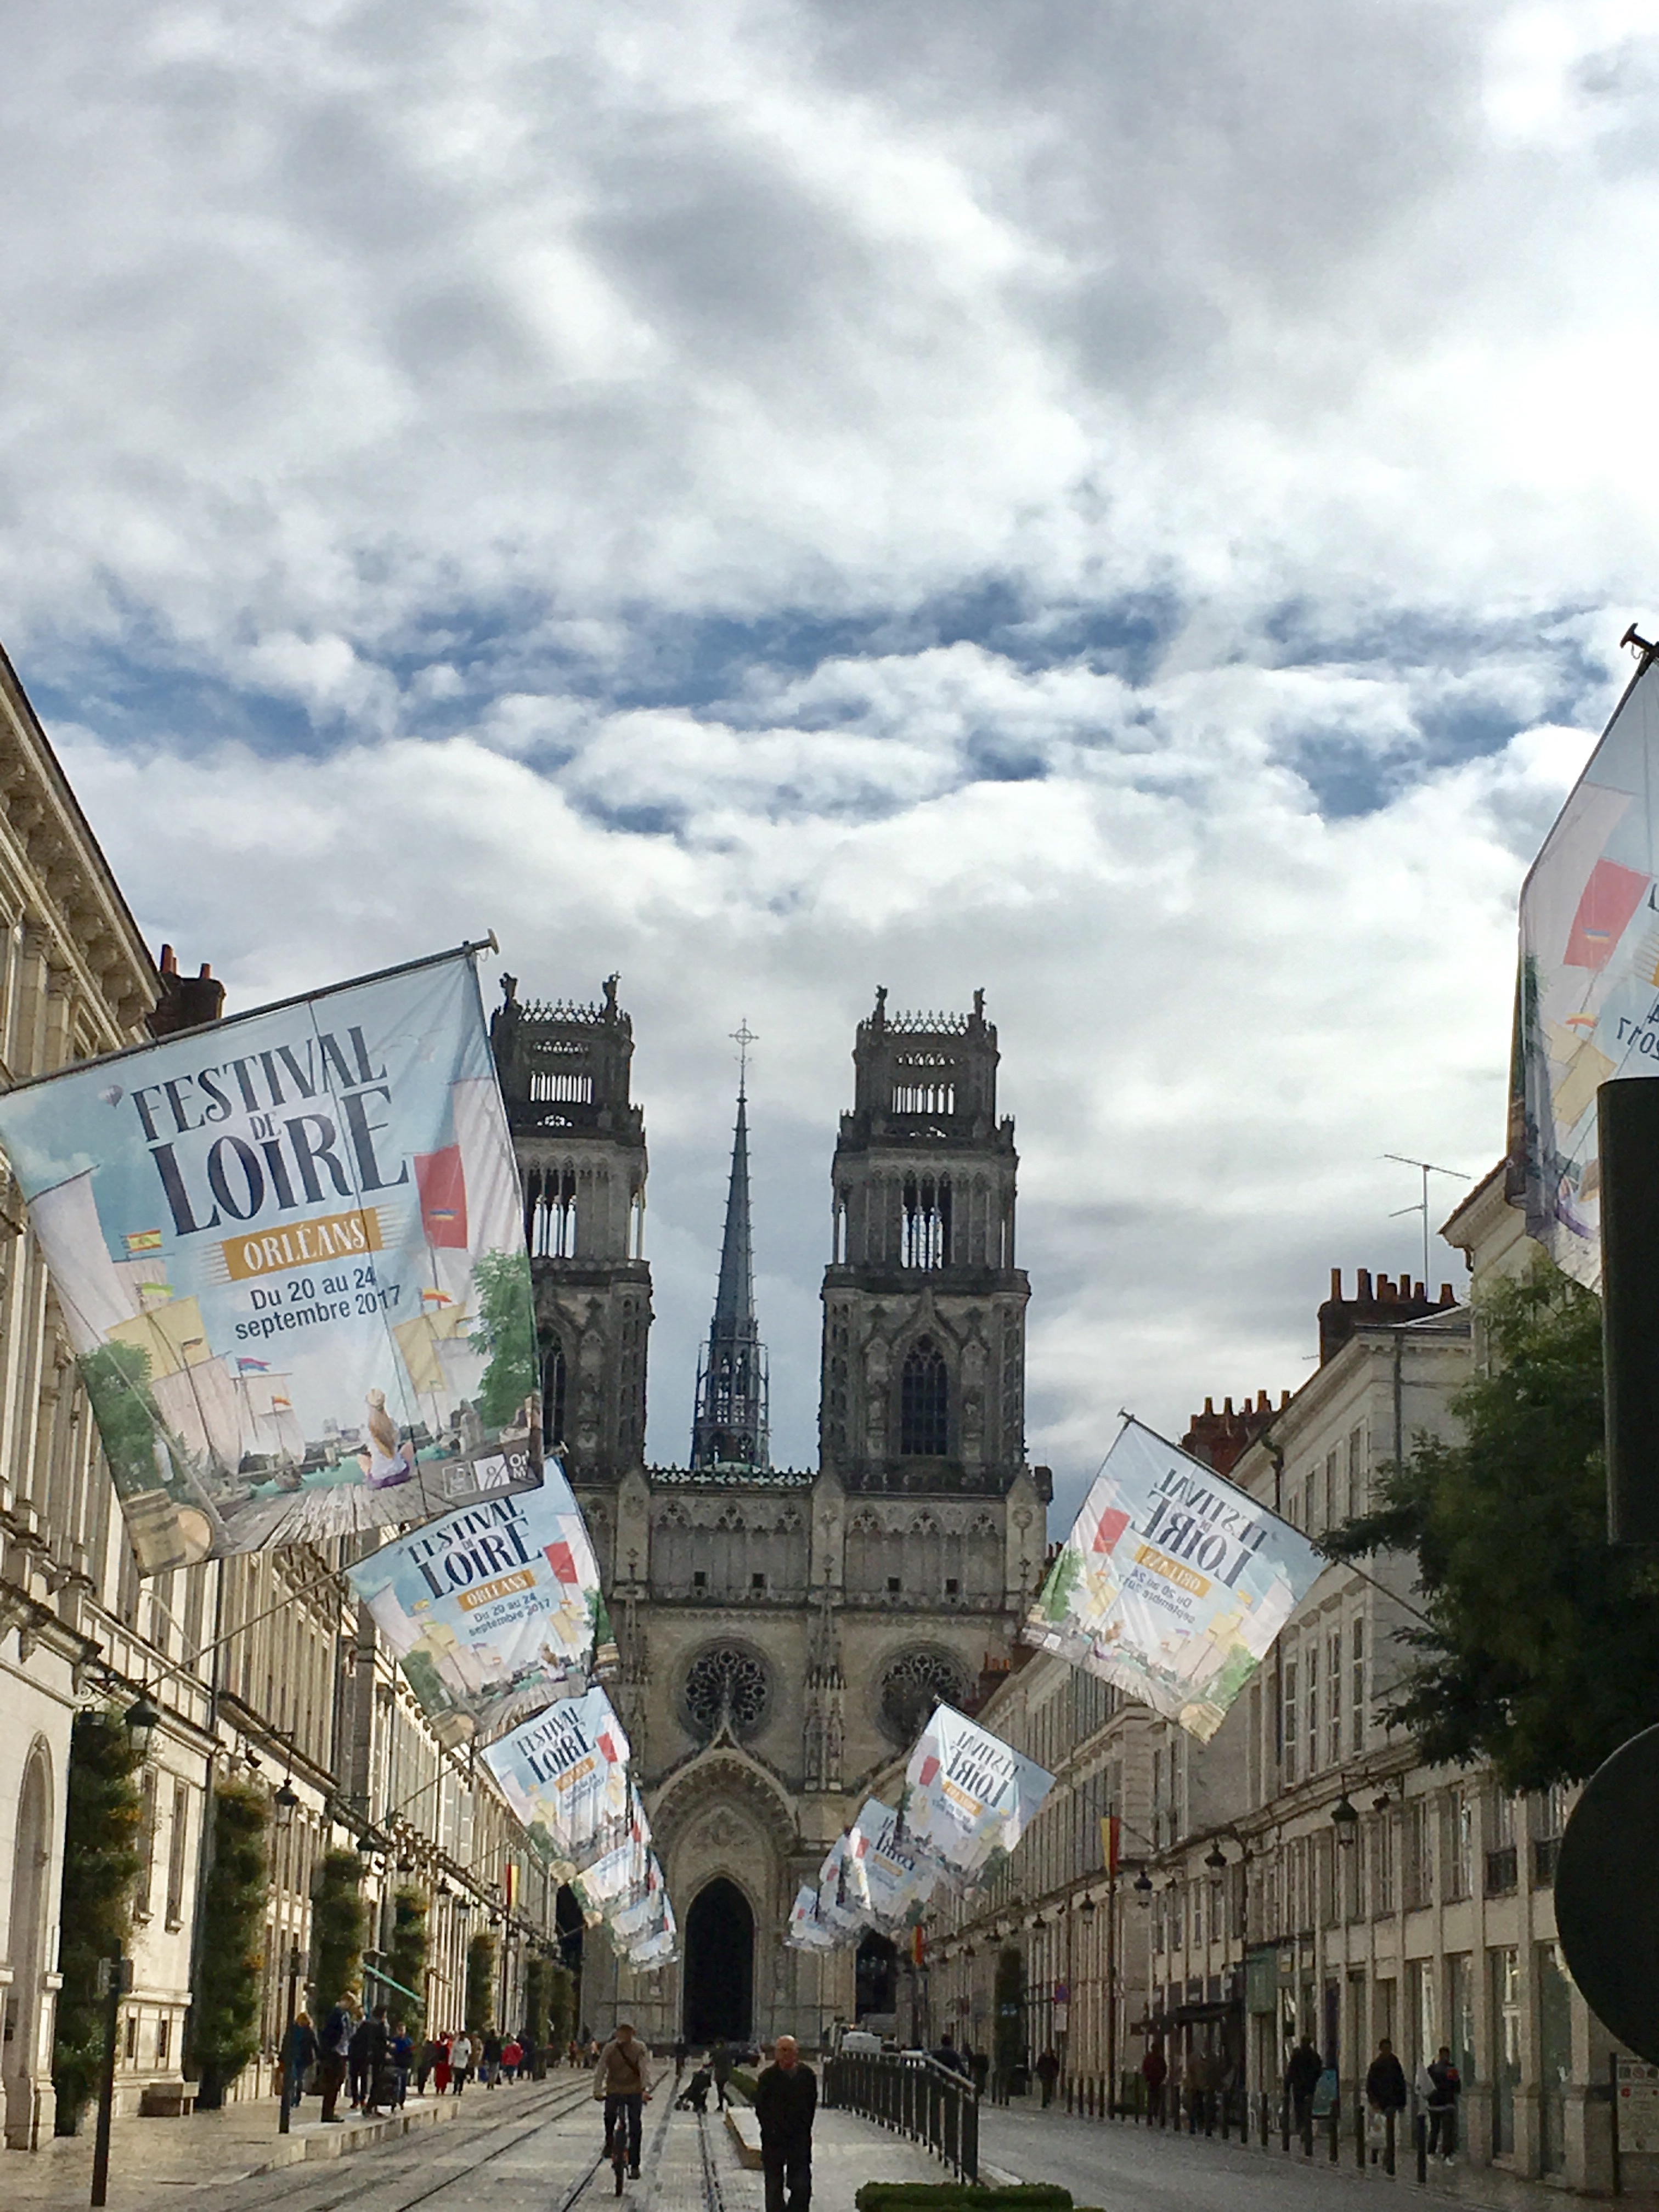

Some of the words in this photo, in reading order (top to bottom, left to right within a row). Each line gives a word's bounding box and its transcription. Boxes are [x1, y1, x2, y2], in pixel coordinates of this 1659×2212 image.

[130, 1026, 387, 1142] FESTIVAL
[249, 1111, 281, 1141] DE
[149, 1086, 409, 1237] LOIRE
[244, 1218, 365, 1271] ORLÉANS
[235, 1300, 351, 1340] septembre
[356, 1285, 400, 1314] 2017
[250, 1289, 282, 1310] Du
[287, 1278, 315, 1302] 20
[323, 1275, 349, 1294] au
[353, 1266, 376, 1288] 24
[408, 1496, 524, 1564] FESTIVAL
[418, 1517, 543, 1599] LOIRE
[492, 1604, 505, 1616] 20
